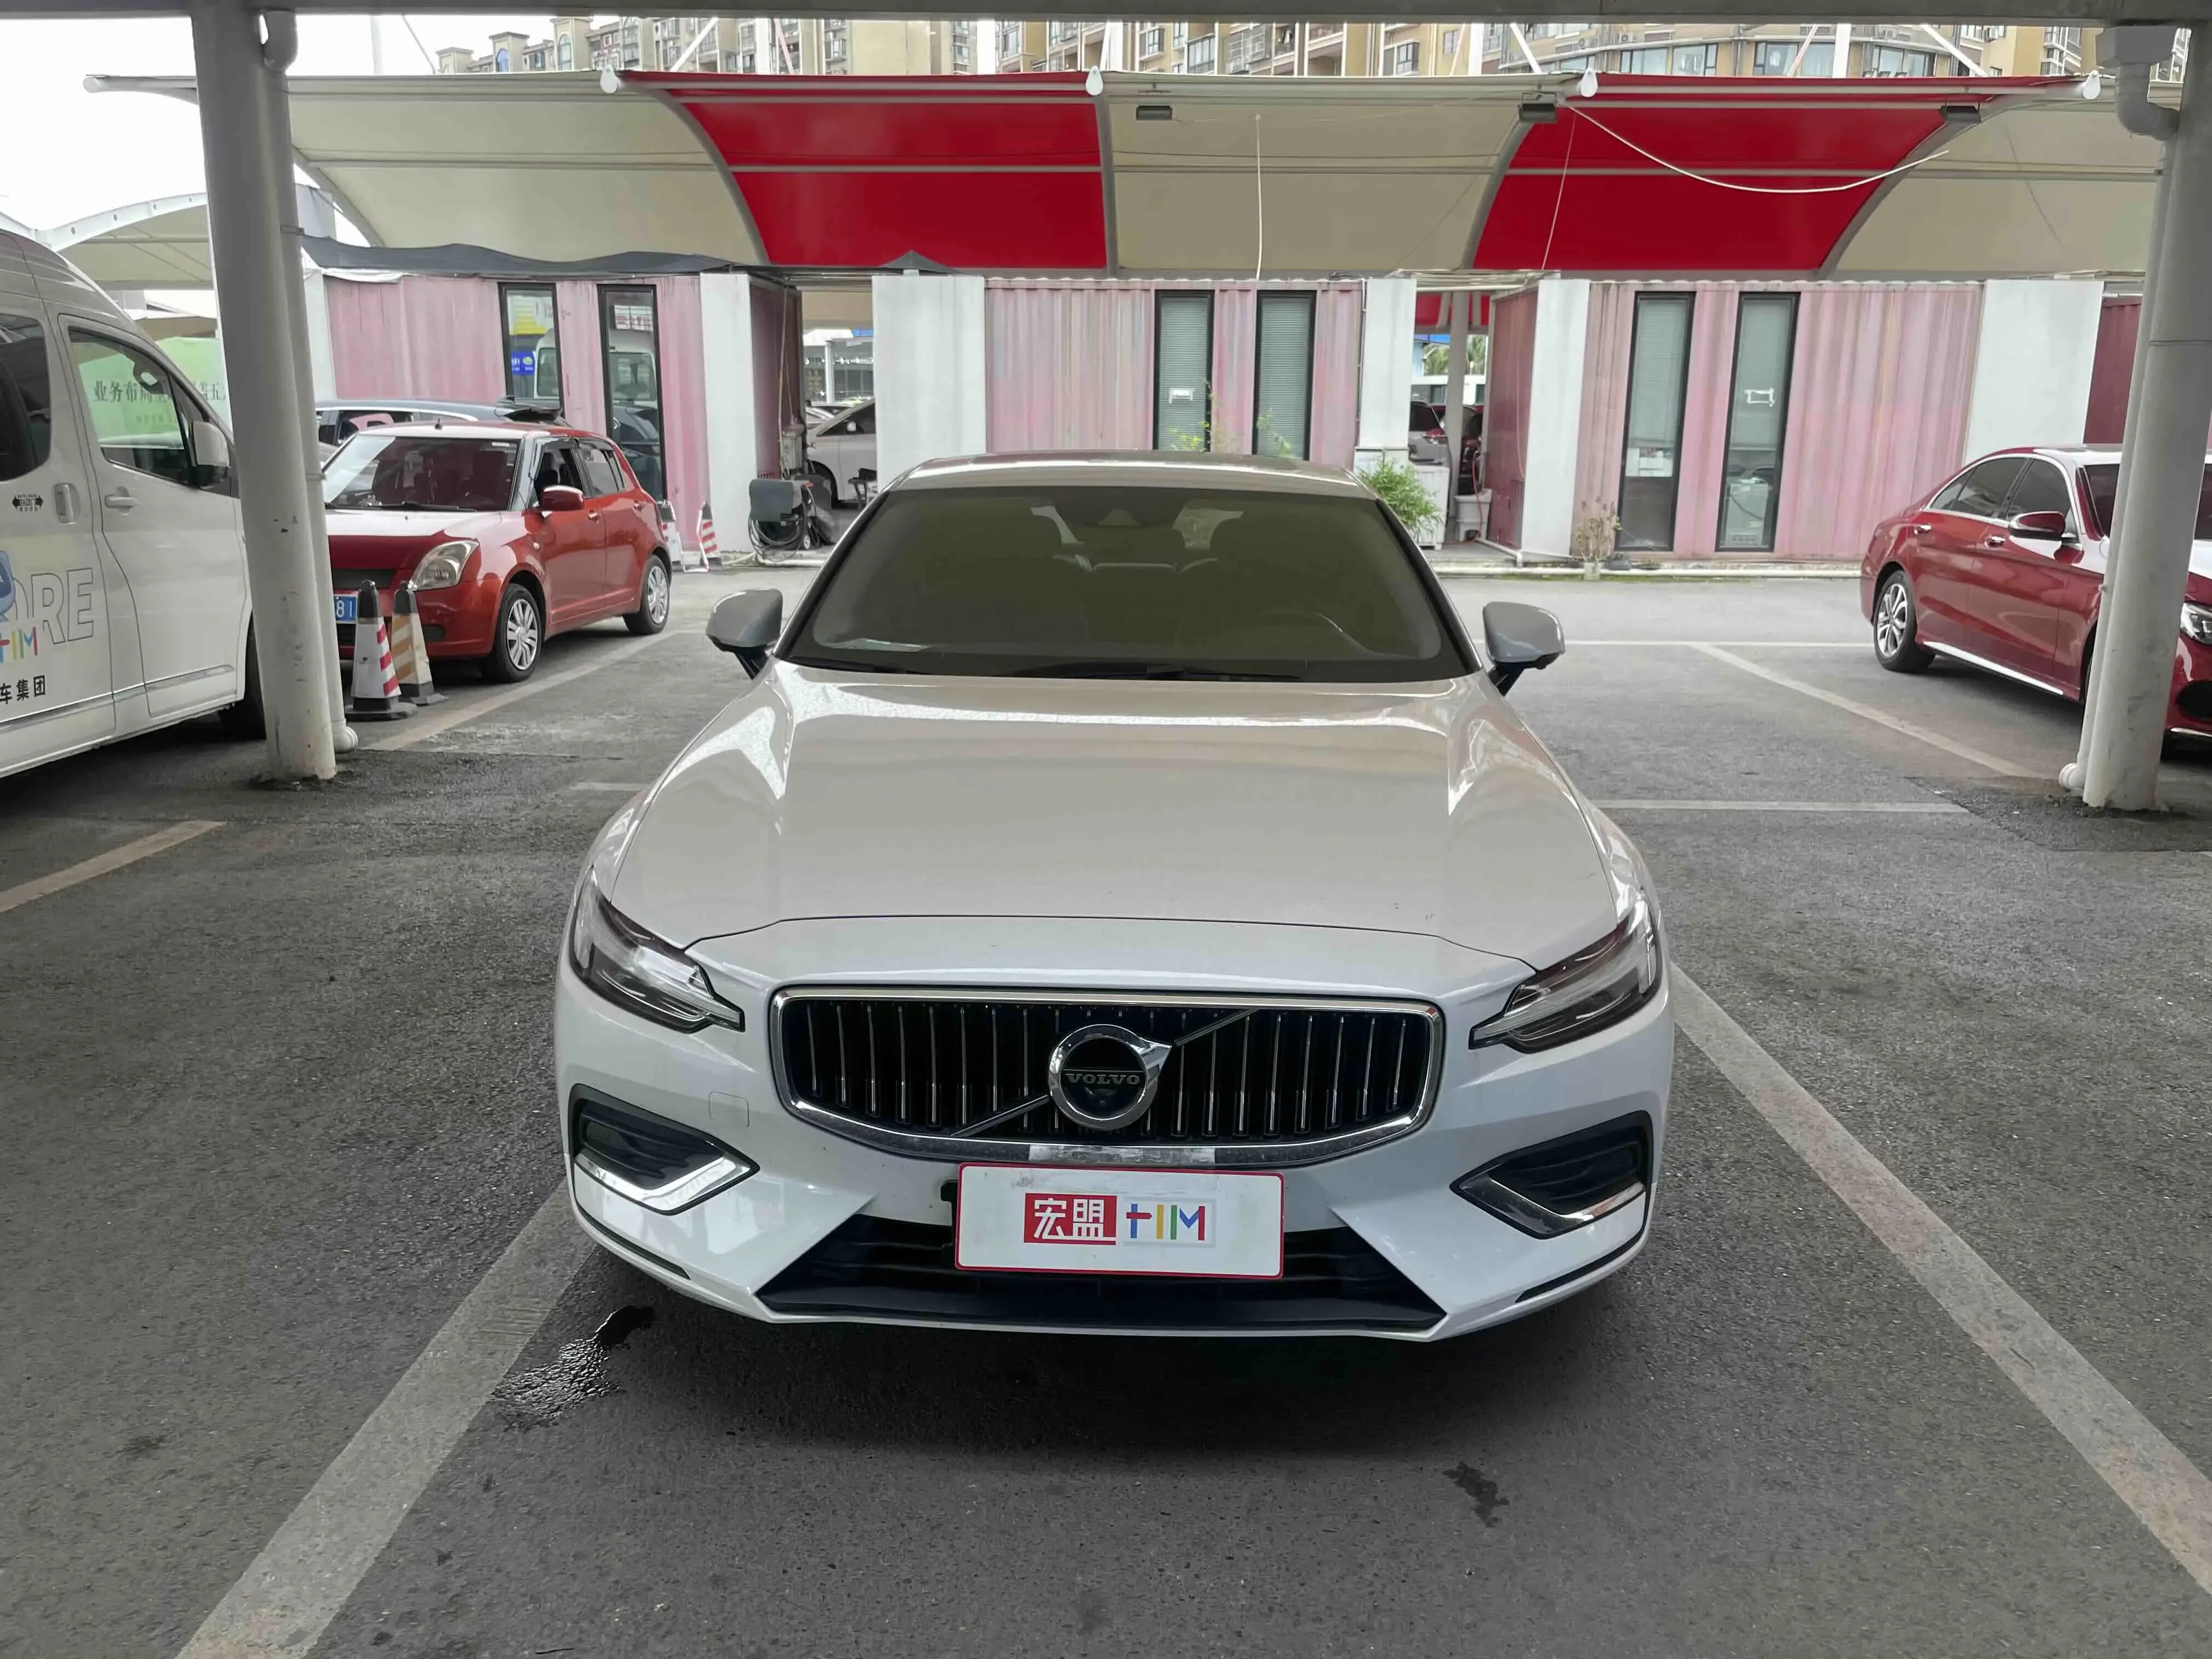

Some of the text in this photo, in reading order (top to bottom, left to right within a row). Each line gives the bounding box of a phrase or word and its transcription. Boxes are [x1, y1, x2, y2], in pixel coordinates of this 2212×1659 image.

[0, 675, 46, 704] 车集团
[1065, 1073, 1140, 1085] VOLVO
[1034, 1198, 1116, 1240] 宏盟
